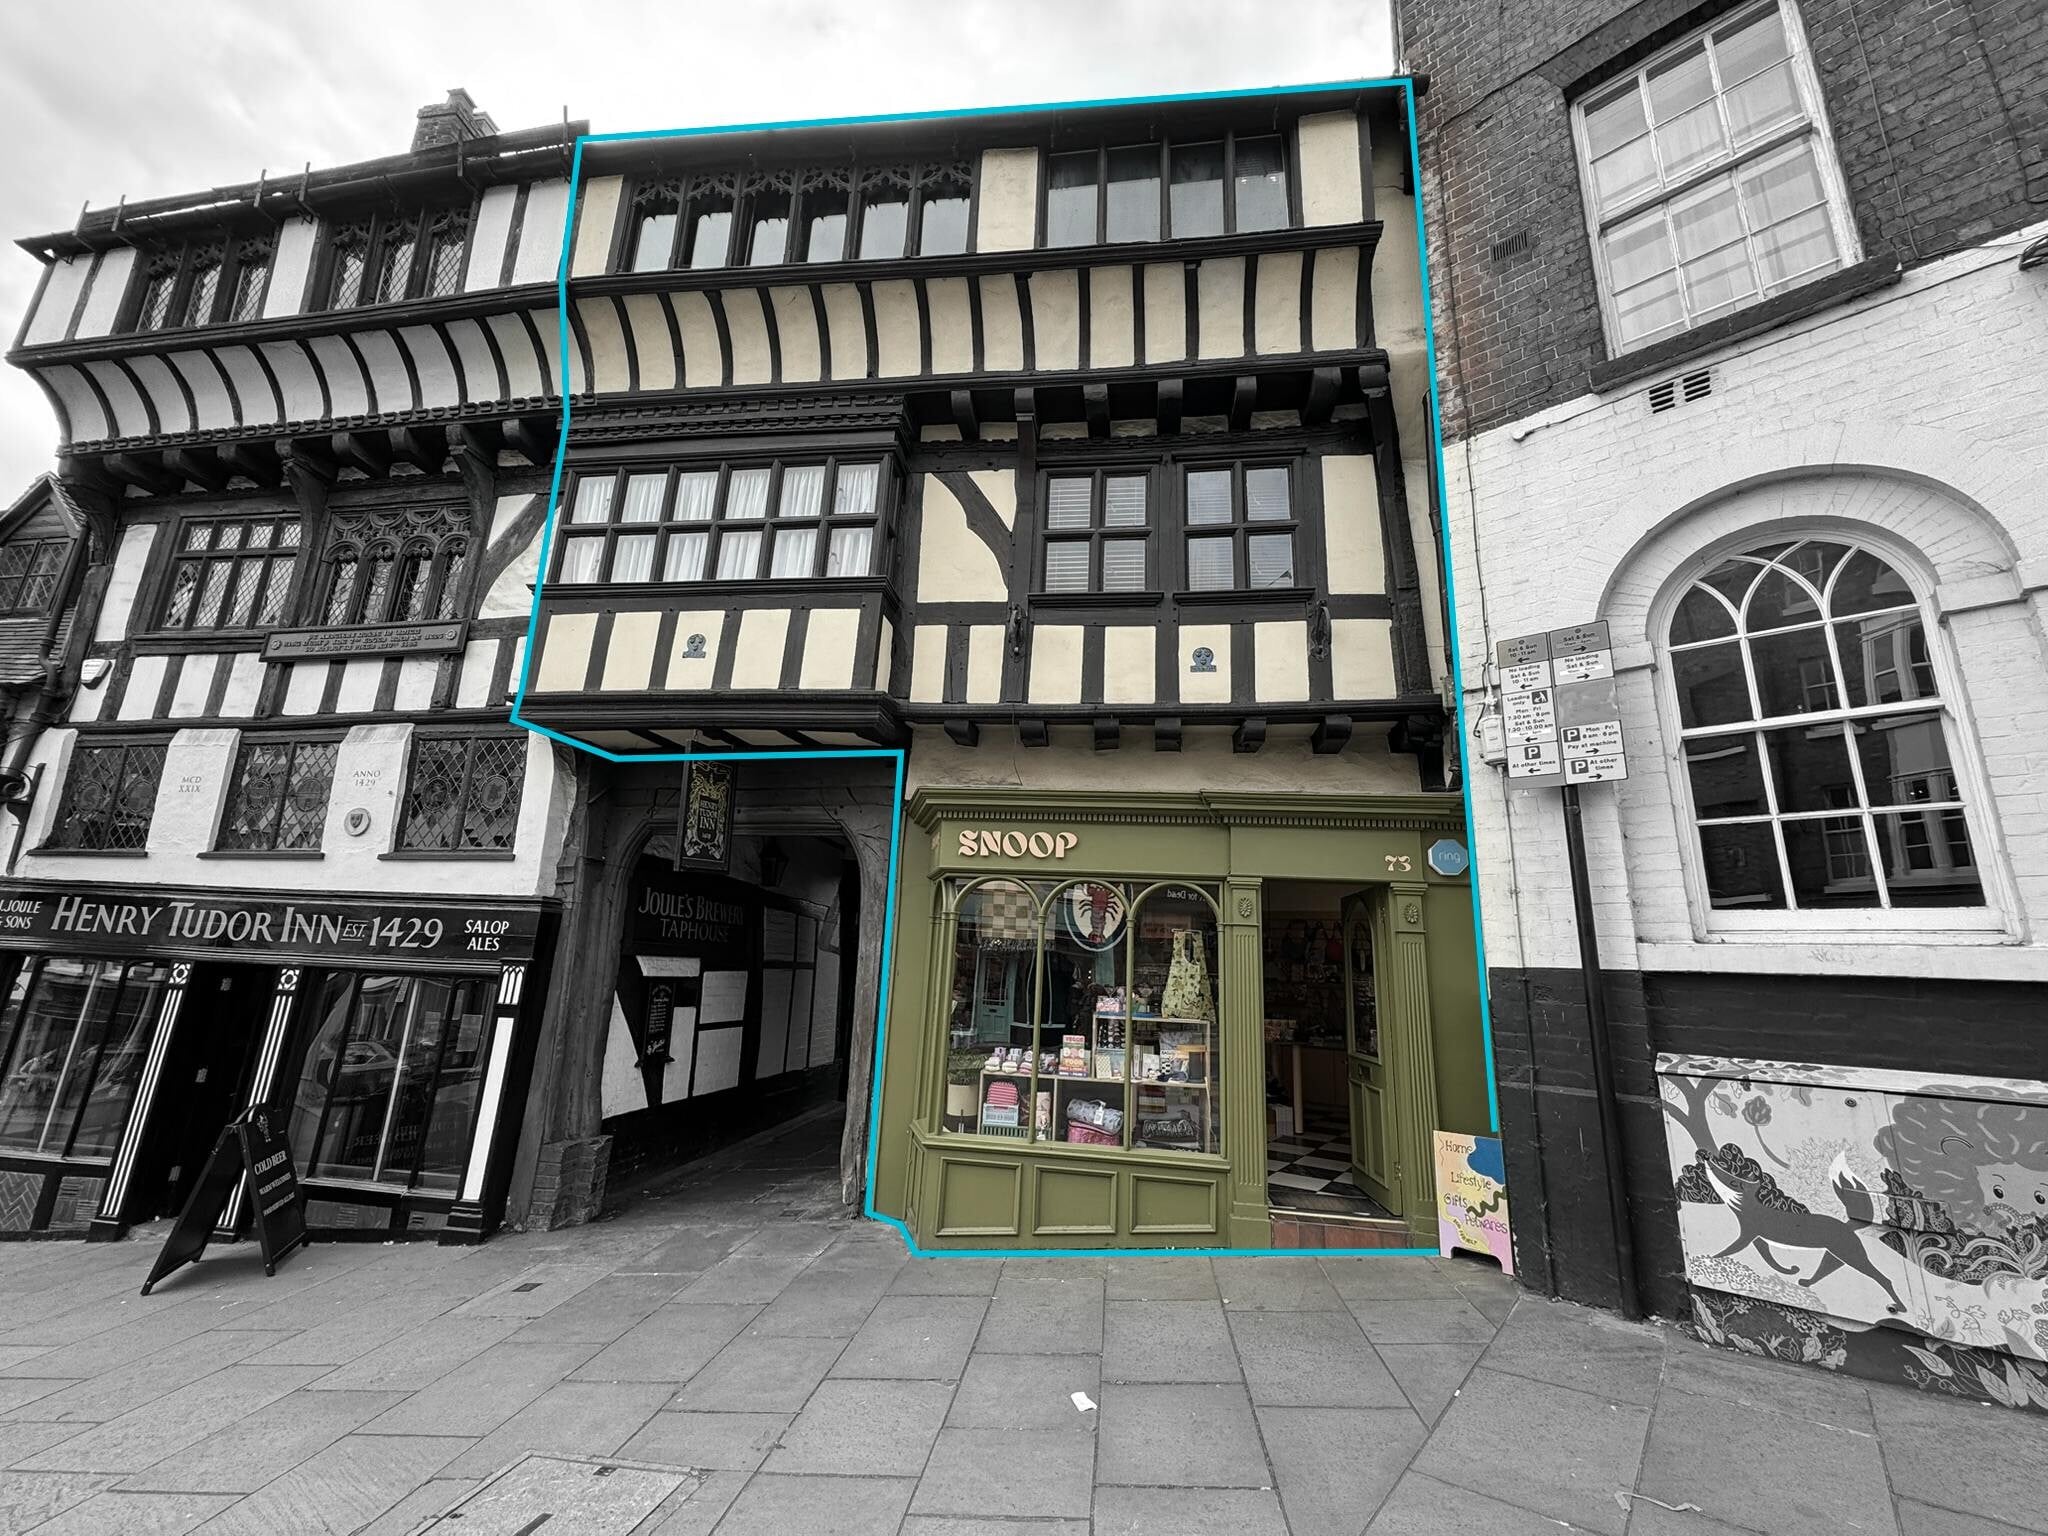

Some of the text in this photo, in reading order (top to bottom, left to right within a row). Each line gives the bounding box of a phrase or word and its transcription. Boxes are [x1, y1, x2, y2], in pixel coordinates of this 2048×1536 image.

[352, 769, 381, 778] ANNO
[699, 816, 716, 830] INN
[958, 829, 1078, 858] SNOOP
[1385, 855, 1412, 872] 73
[1438, 851, 1461, 864] ring
[3, 899, 43, 914] JOULE
[3, 915, 33, 930] SONS
[50, 896, 163, 935] HENRY
[168, 901, 274, 942] TUDOR
[280, 906, 344, 945] INN
[368, 915, 444, 949] 1429
[464, 919, 510, 935] SALOP
[466, 936, 500, 951] ALES
[1445, 1140, 1473, 1154] Home
[254, 1157, 273, 1176] COLD
[1450, 1171, 1492, 1192] Lifestyle
[1443, 1193, 1468, 1209] Gifts
